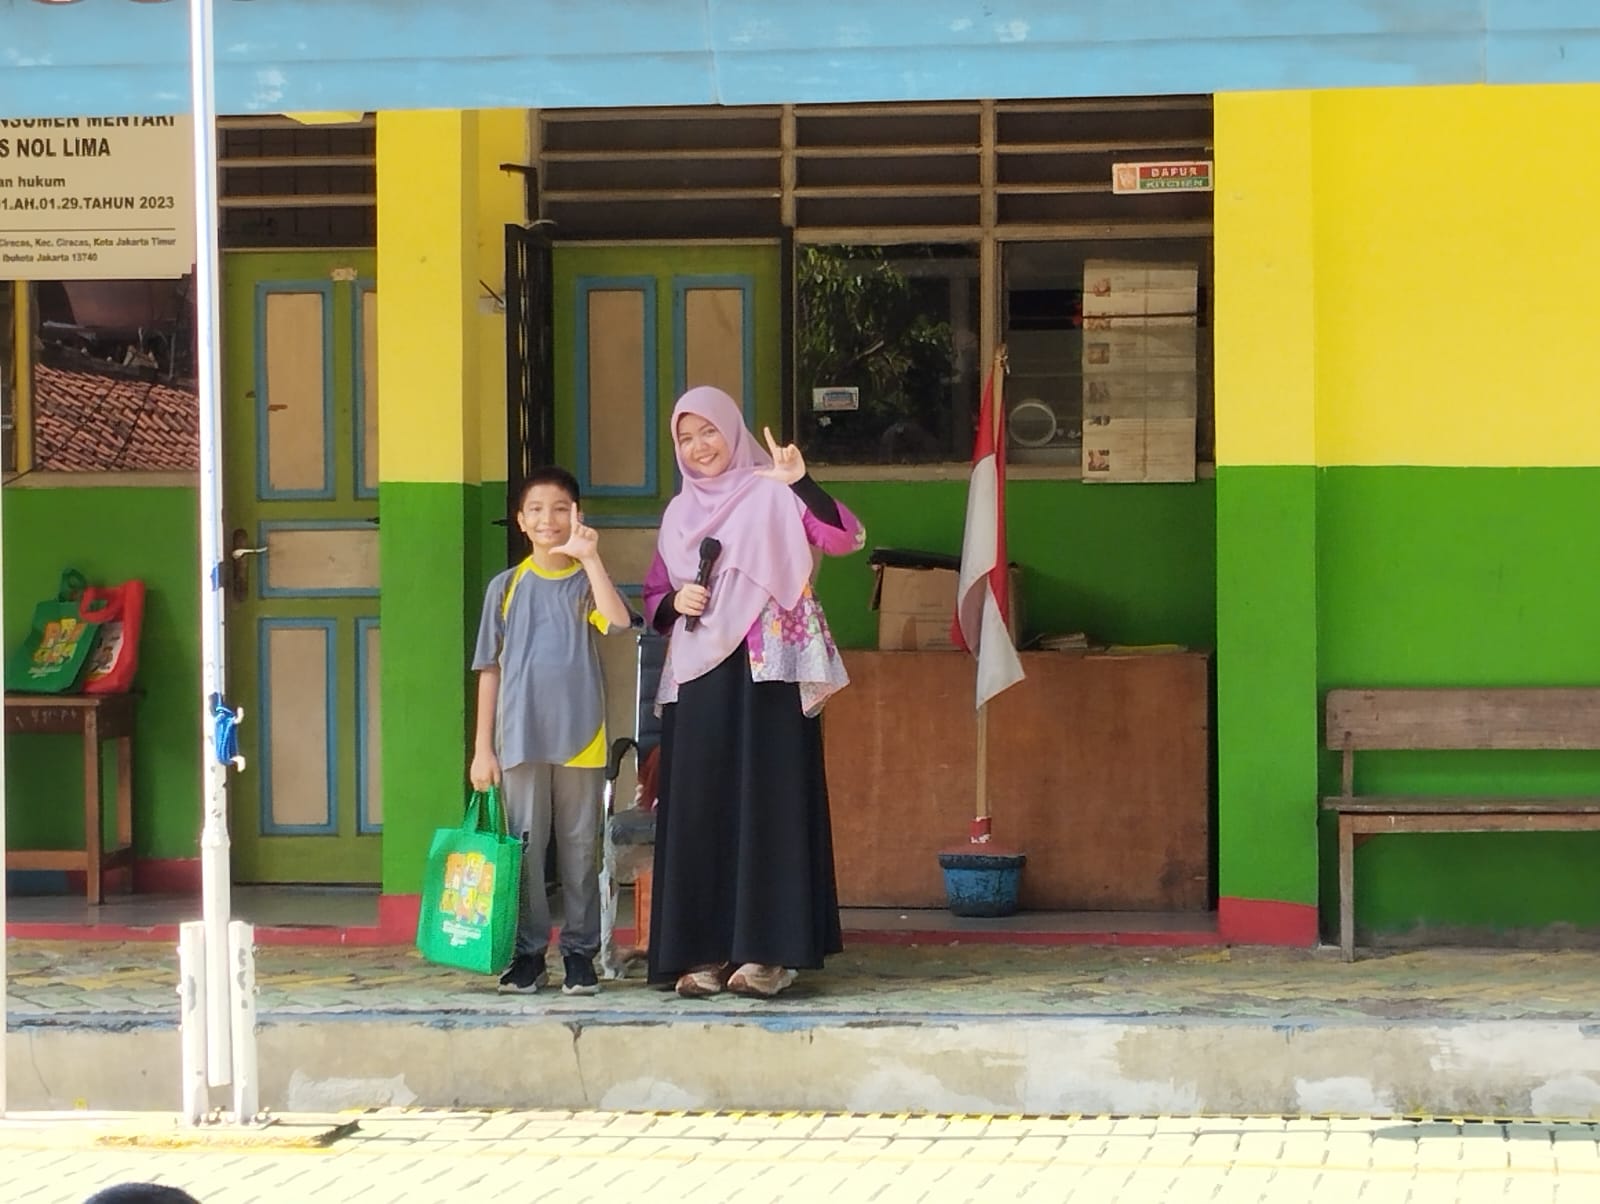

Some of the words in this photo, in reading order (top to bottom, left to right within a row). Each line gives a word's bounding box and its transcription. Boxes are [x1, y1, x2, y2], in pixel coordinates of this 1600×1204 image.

[17, 138, 57, 158] NOL
[63, 137, 111, 157] LIMA
[1151, 167, 1197, 178] DAPUR
[18, 175, 66, 188] hukum
[1146, 179, 1203, 188] KITCHEN
[139, 195, 175, 210] 2023
[116, 237, 149, 246] Jakarta
[151, 236, 177, 246] Timur
[37, 252, 70, 262] Jakarta
